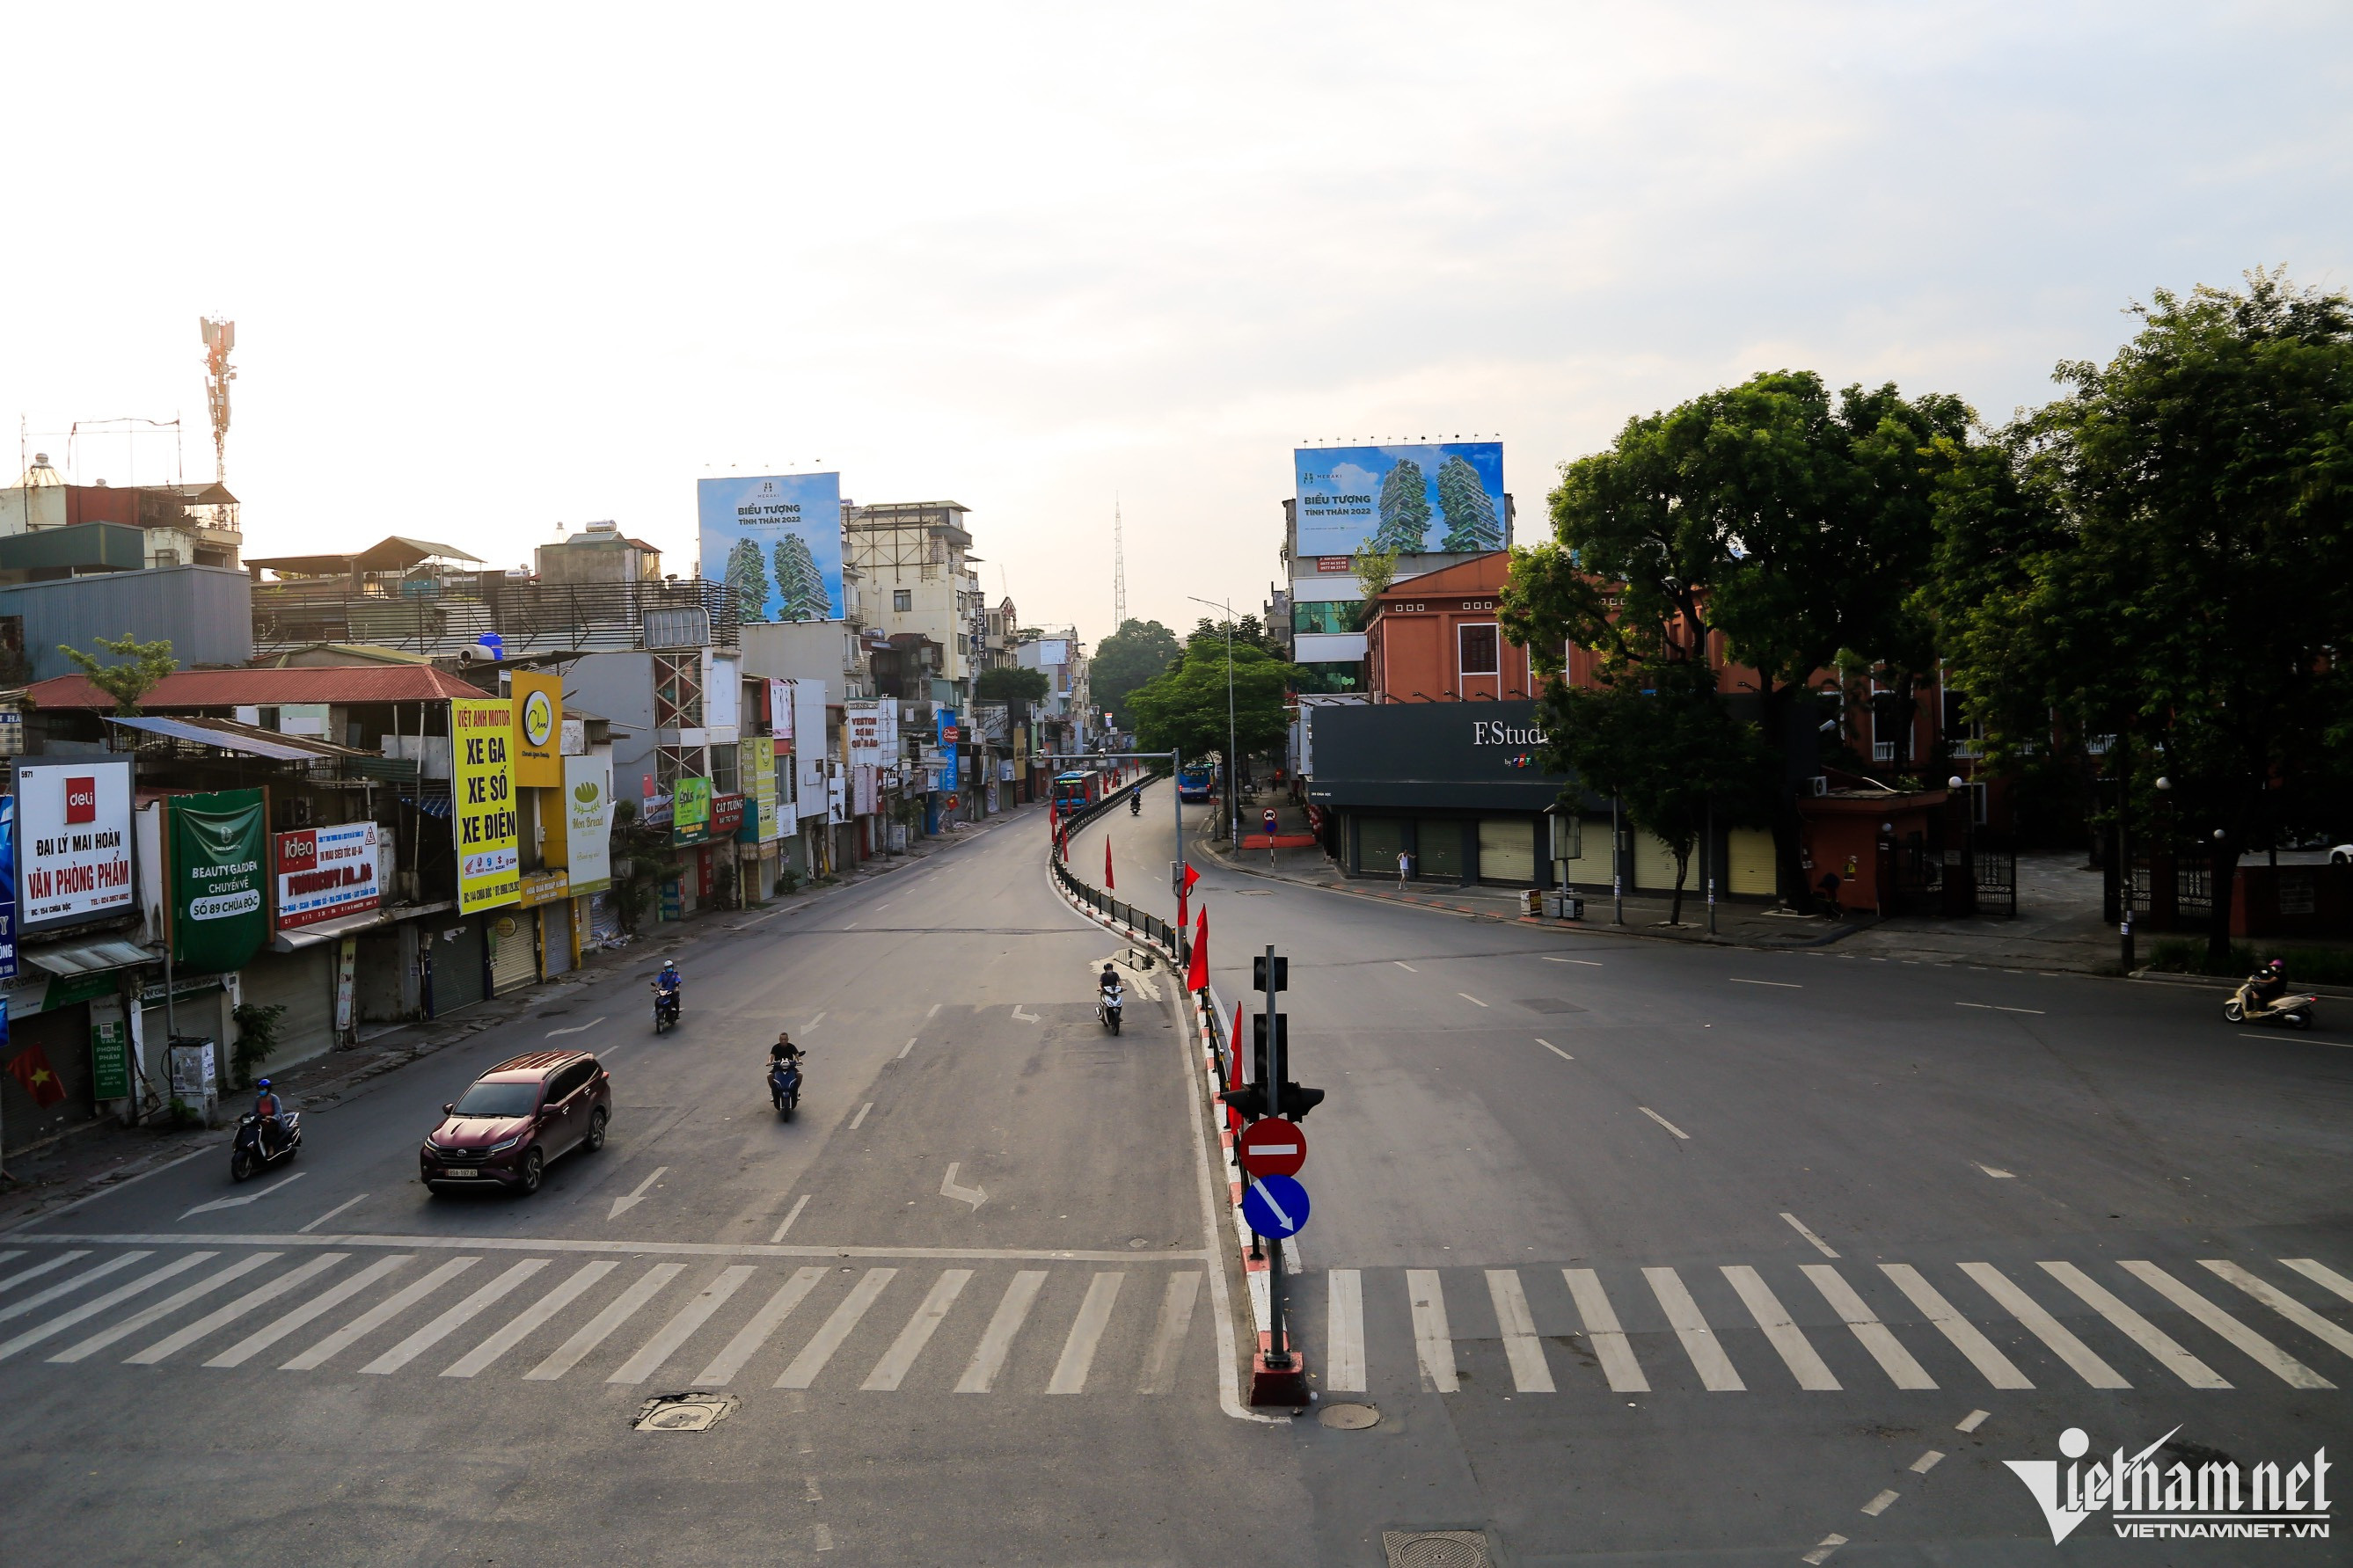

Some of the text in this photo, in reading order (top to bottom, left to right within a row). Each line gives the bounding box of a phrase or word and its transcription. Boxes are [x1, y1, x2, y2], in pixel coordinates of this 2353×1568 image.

[738, 503, 800, 515] BIỂU TƯỢNG
[1304, 492, 1371, 506] BIỂU TƯỢNG
[457, 706, 471, 731] VIỆT
[473, 711, 487, 727] ANH
[488, 710, 510, 726] MOTOR
[1473, 721, 1557, 745] F.Stud
[466, 737, 507, 765] XE GA
[1504, 755, 1531, 767] by FPT
[467, 765, 508, 804] XE SỐ
[69, 792, 93, 806] deli
[462, 806, 516, 844] XE ĐIỆN
[572, 816, 603, 830] Mon Bread
[36, 828, 121, 858] ĐẠI LÝ MAI HOÀN
[284, 837, 314, 859] idea
[28, 850, 129, 900] VĂN PHÒNG PHẨM
[192, 861, 258, 879] BEAUTY GARDEN
[194, 900, 208, 915] SỐ
[209, 903, 221, 915] 89
[223, 898, 243, 912] CHÙA
